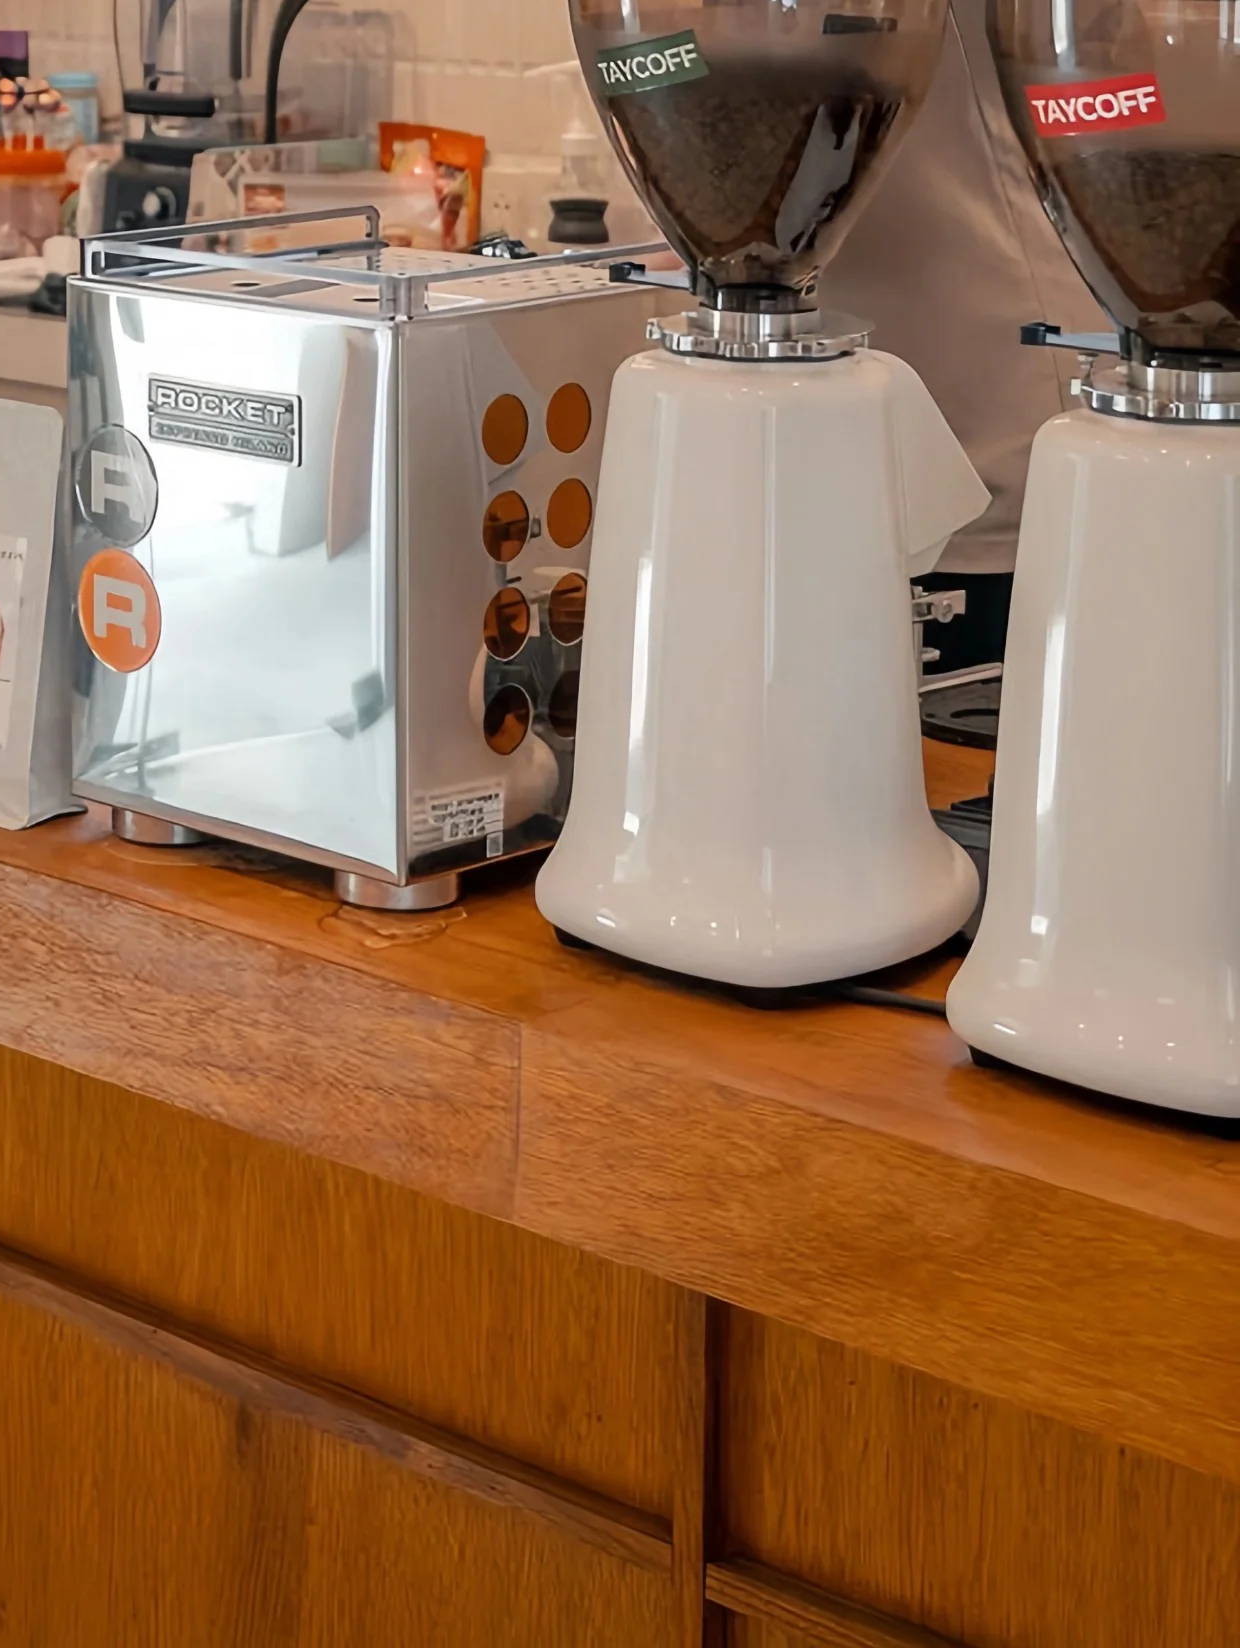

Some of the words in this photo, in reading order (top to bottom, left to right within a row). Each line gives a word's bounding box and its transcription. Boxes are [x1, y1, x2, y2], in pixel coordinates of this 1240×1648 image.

[597, 43, 698, 84] TAYCOFF
[1031, 85, 1157, 124] TAYCOFF
[156, 386, 288, 426] ROCKET
[91, 449, 146, 524] R
[93, 573, 147, 649] R
